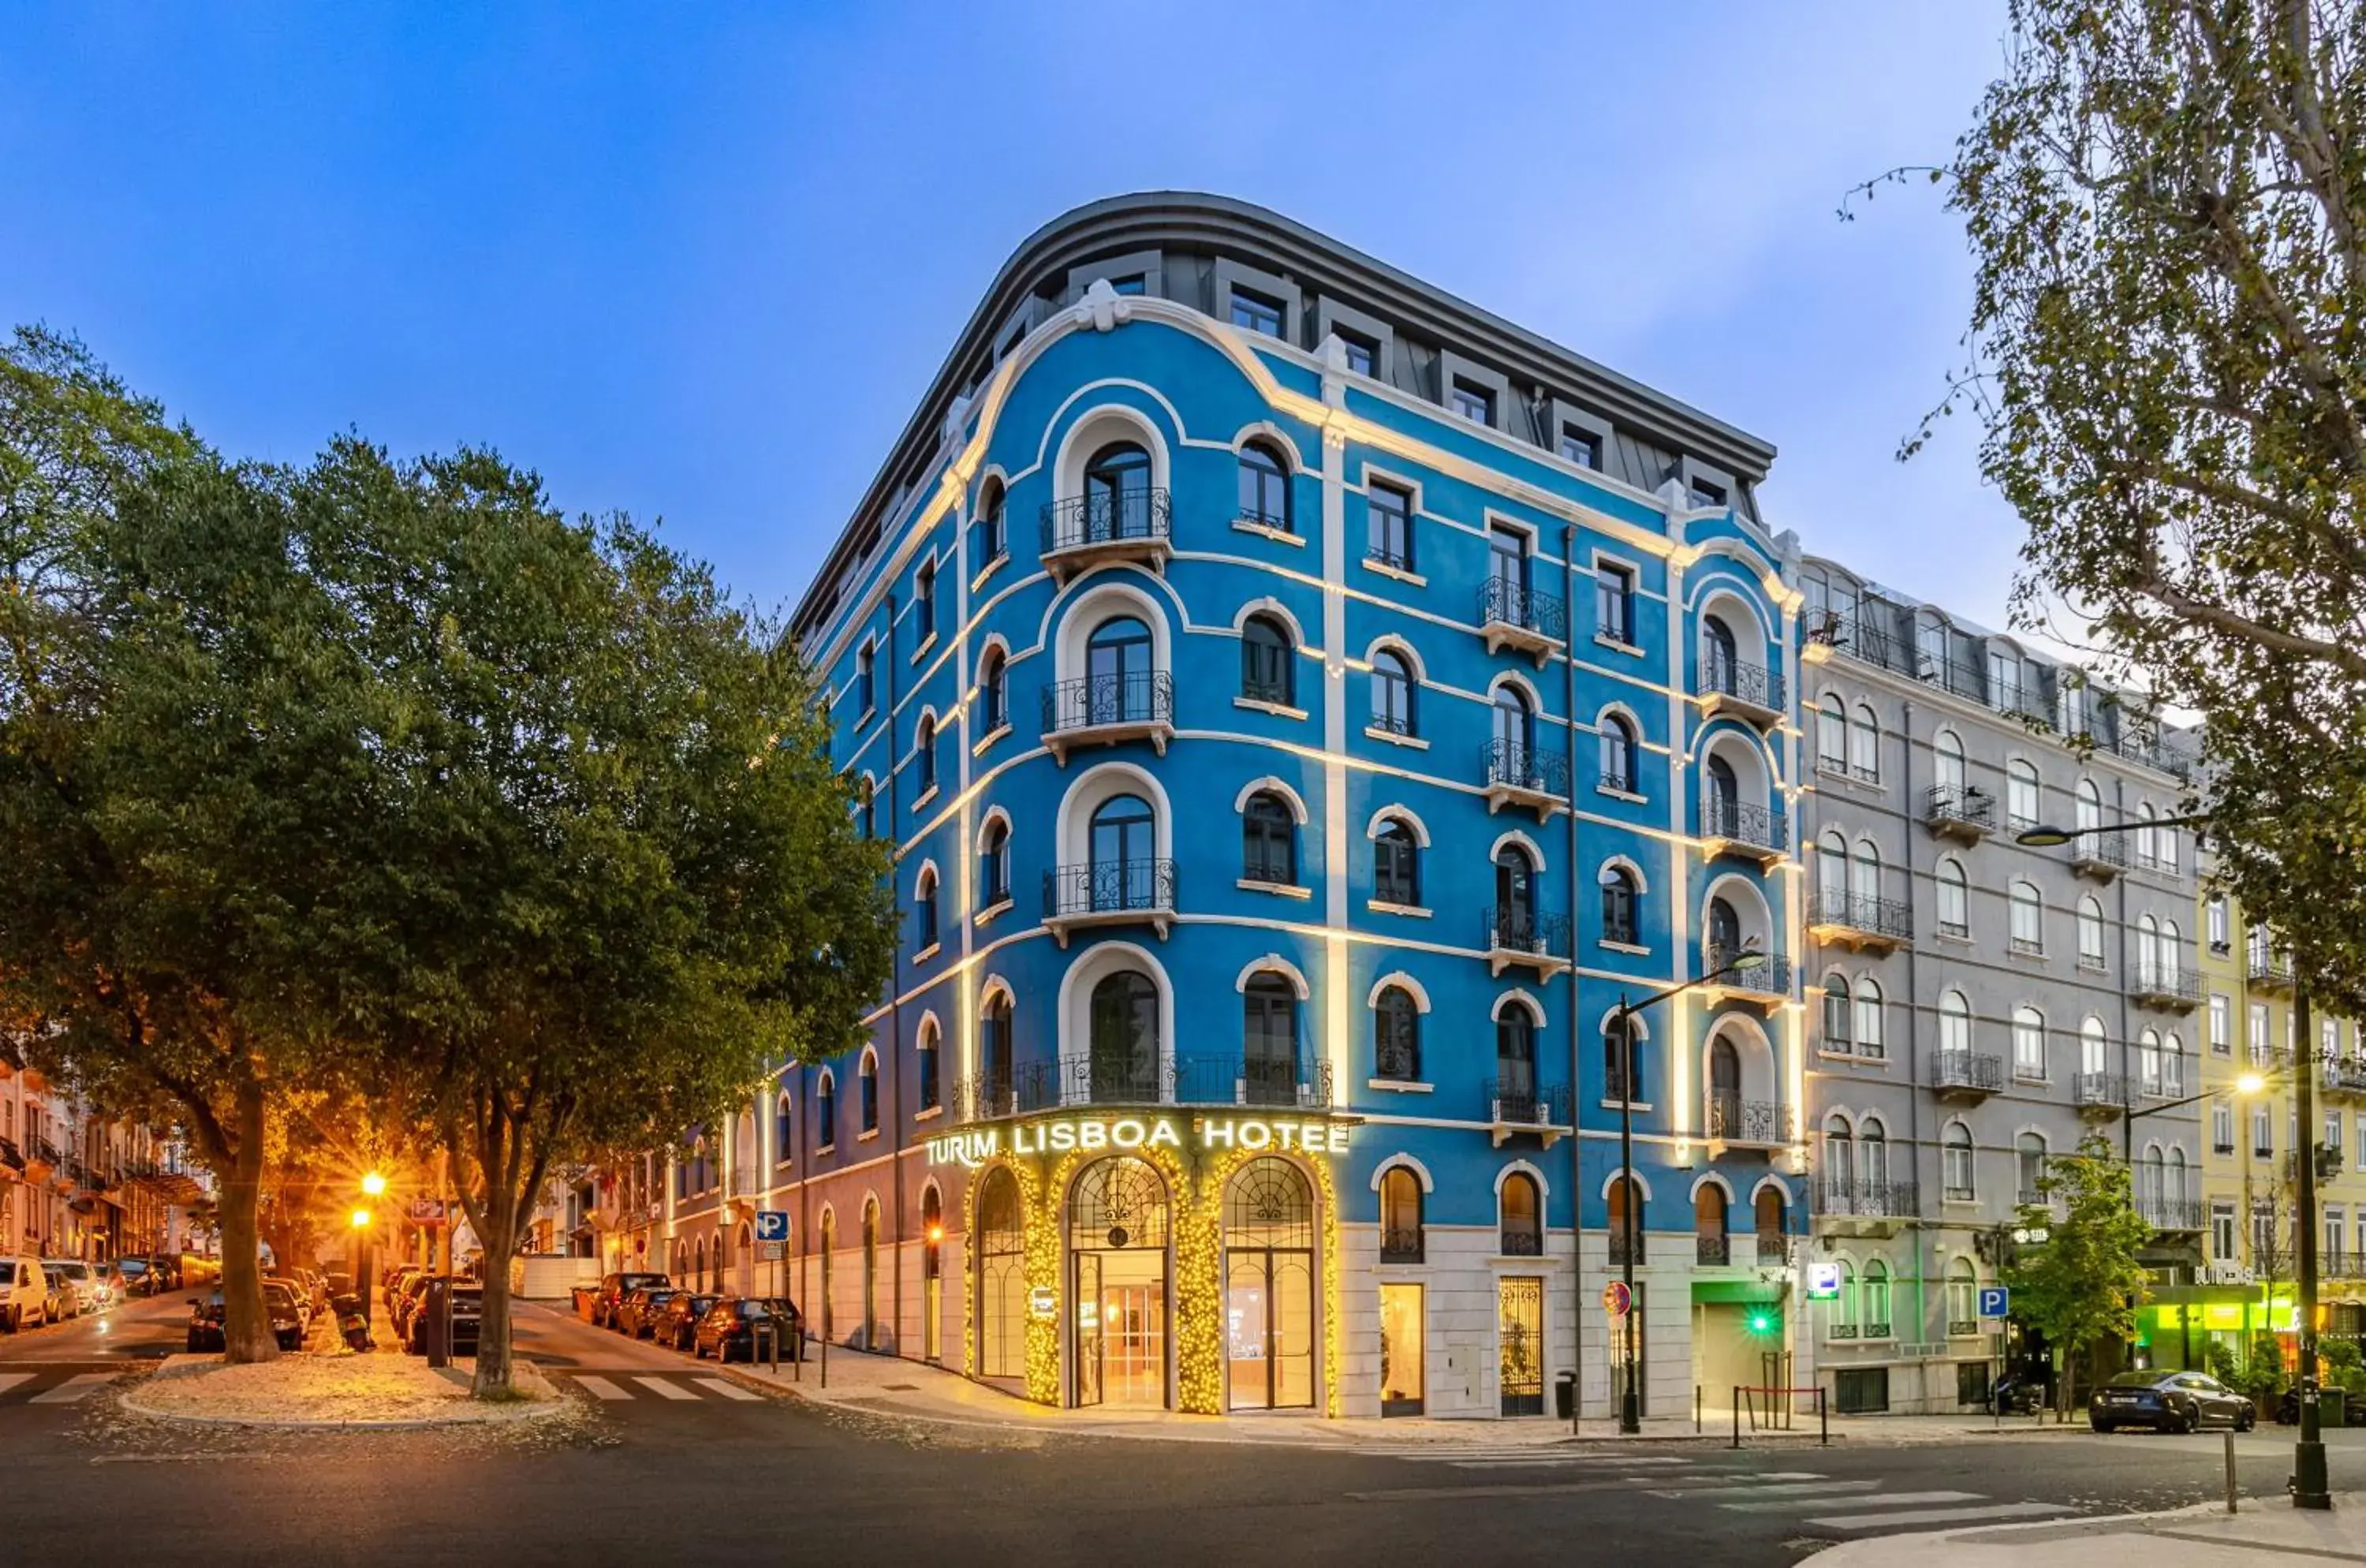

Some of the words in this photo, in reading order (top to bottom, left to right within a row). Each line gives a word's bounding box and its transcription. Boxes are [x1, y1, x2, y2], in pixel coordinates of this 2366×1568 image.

[926, 1130, 997, 1168] TURIM
[1013, 1120, 1181, 1153] LISBOA
[763, 1215, 782, 1237] P
[1812, 1264, 1834, 1289] P
[1985, 1291, 2001, 1312] P
